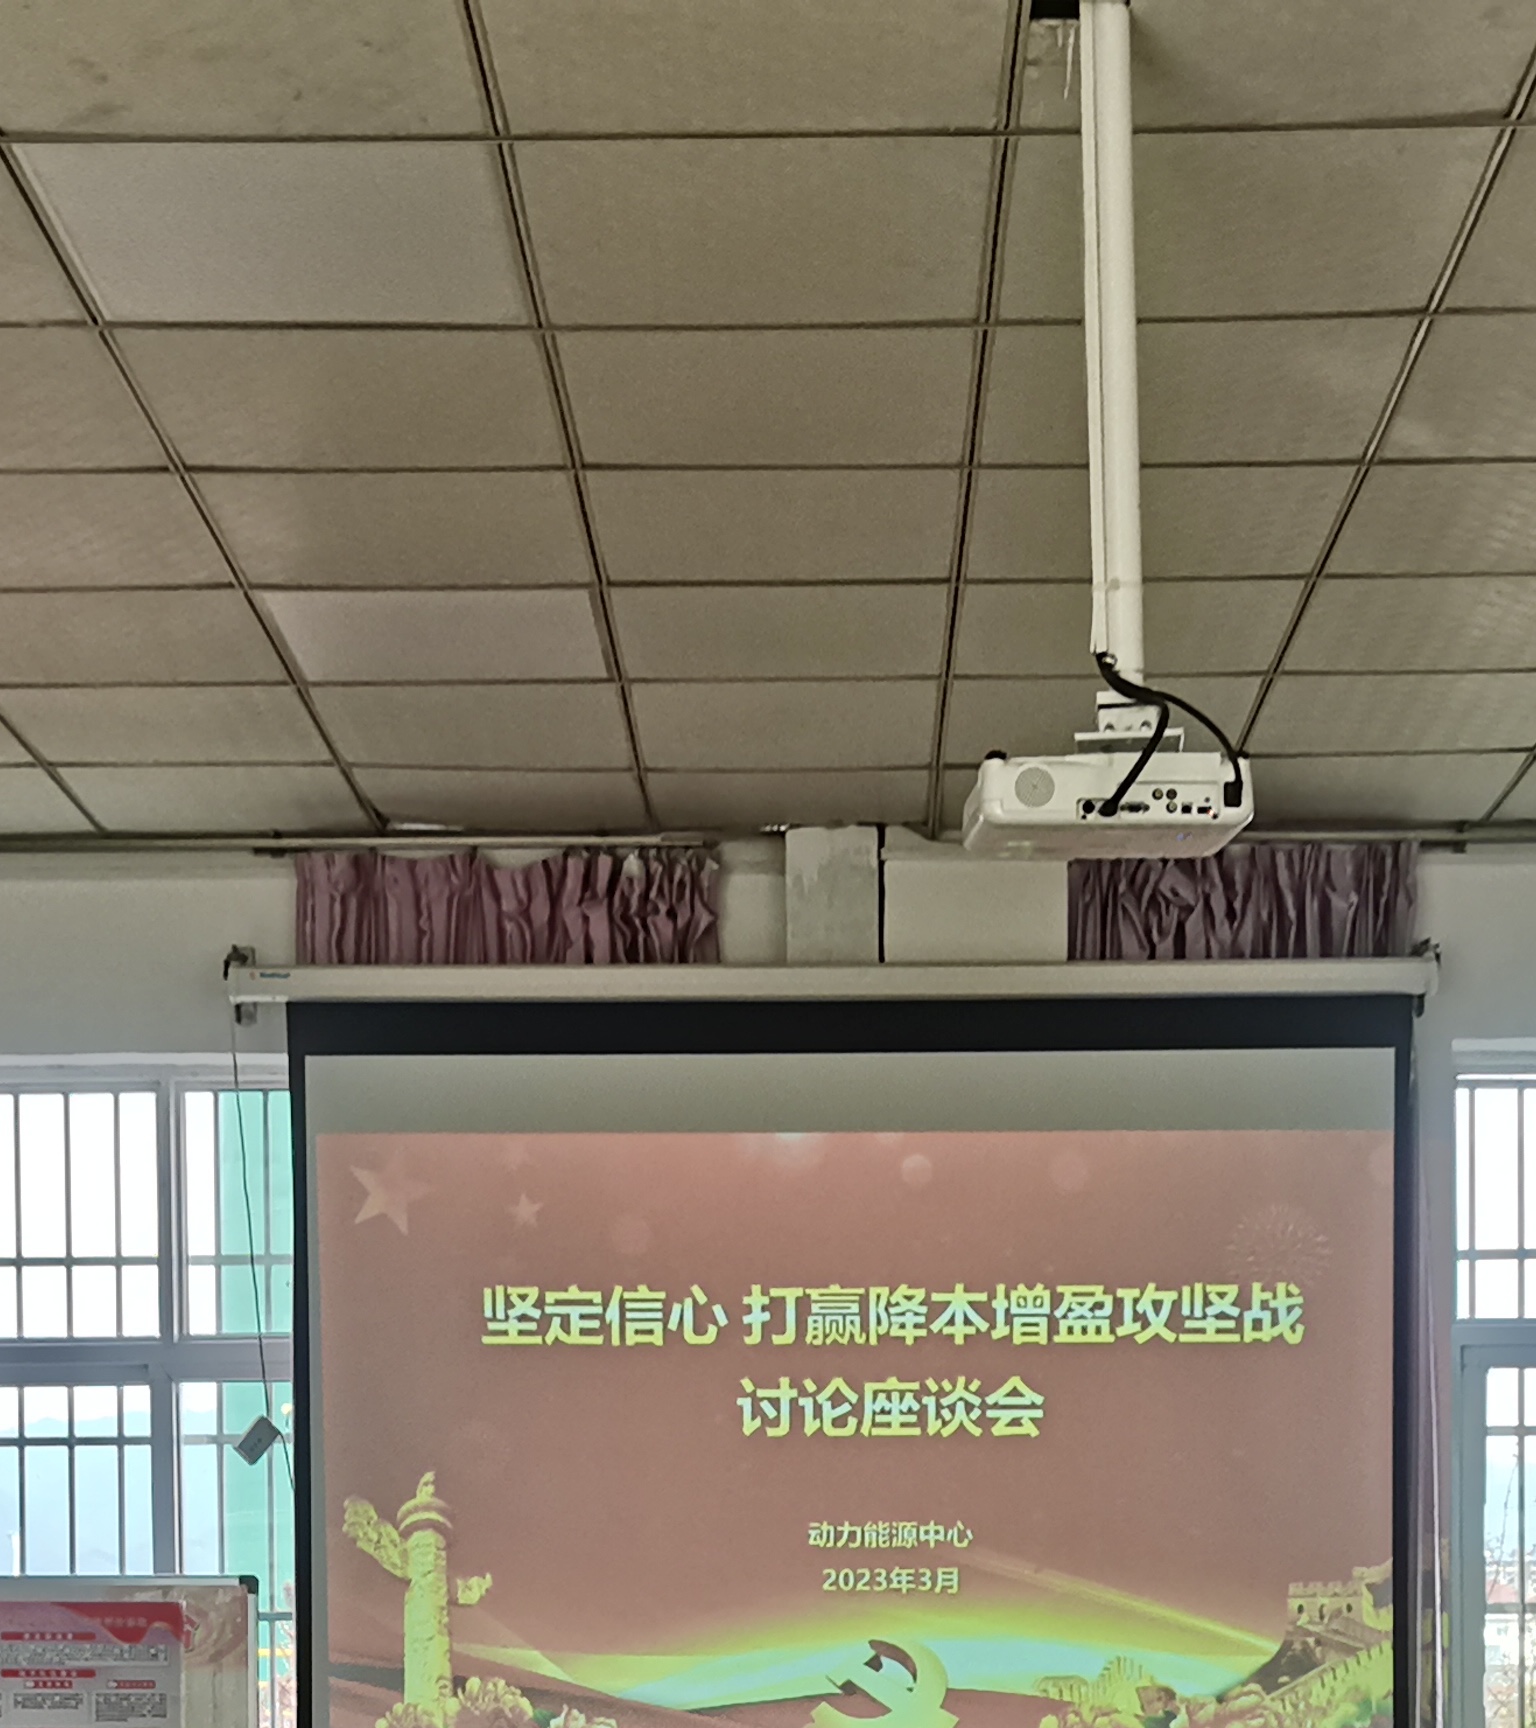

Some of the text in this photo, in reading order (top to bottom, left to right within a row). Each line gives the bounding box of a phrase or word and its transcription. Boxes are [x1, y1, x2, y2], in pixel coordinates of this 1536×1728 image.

[481, 1281, 1305, 1347] 坚定信心 打赢降本增盈攻坚战
[736, 1375, 1046, 1438] 讨论座谈会
[808, 1520, 974, 1549] 动力能源中心
[822, 1566, 960, 1595] 2023年3月
